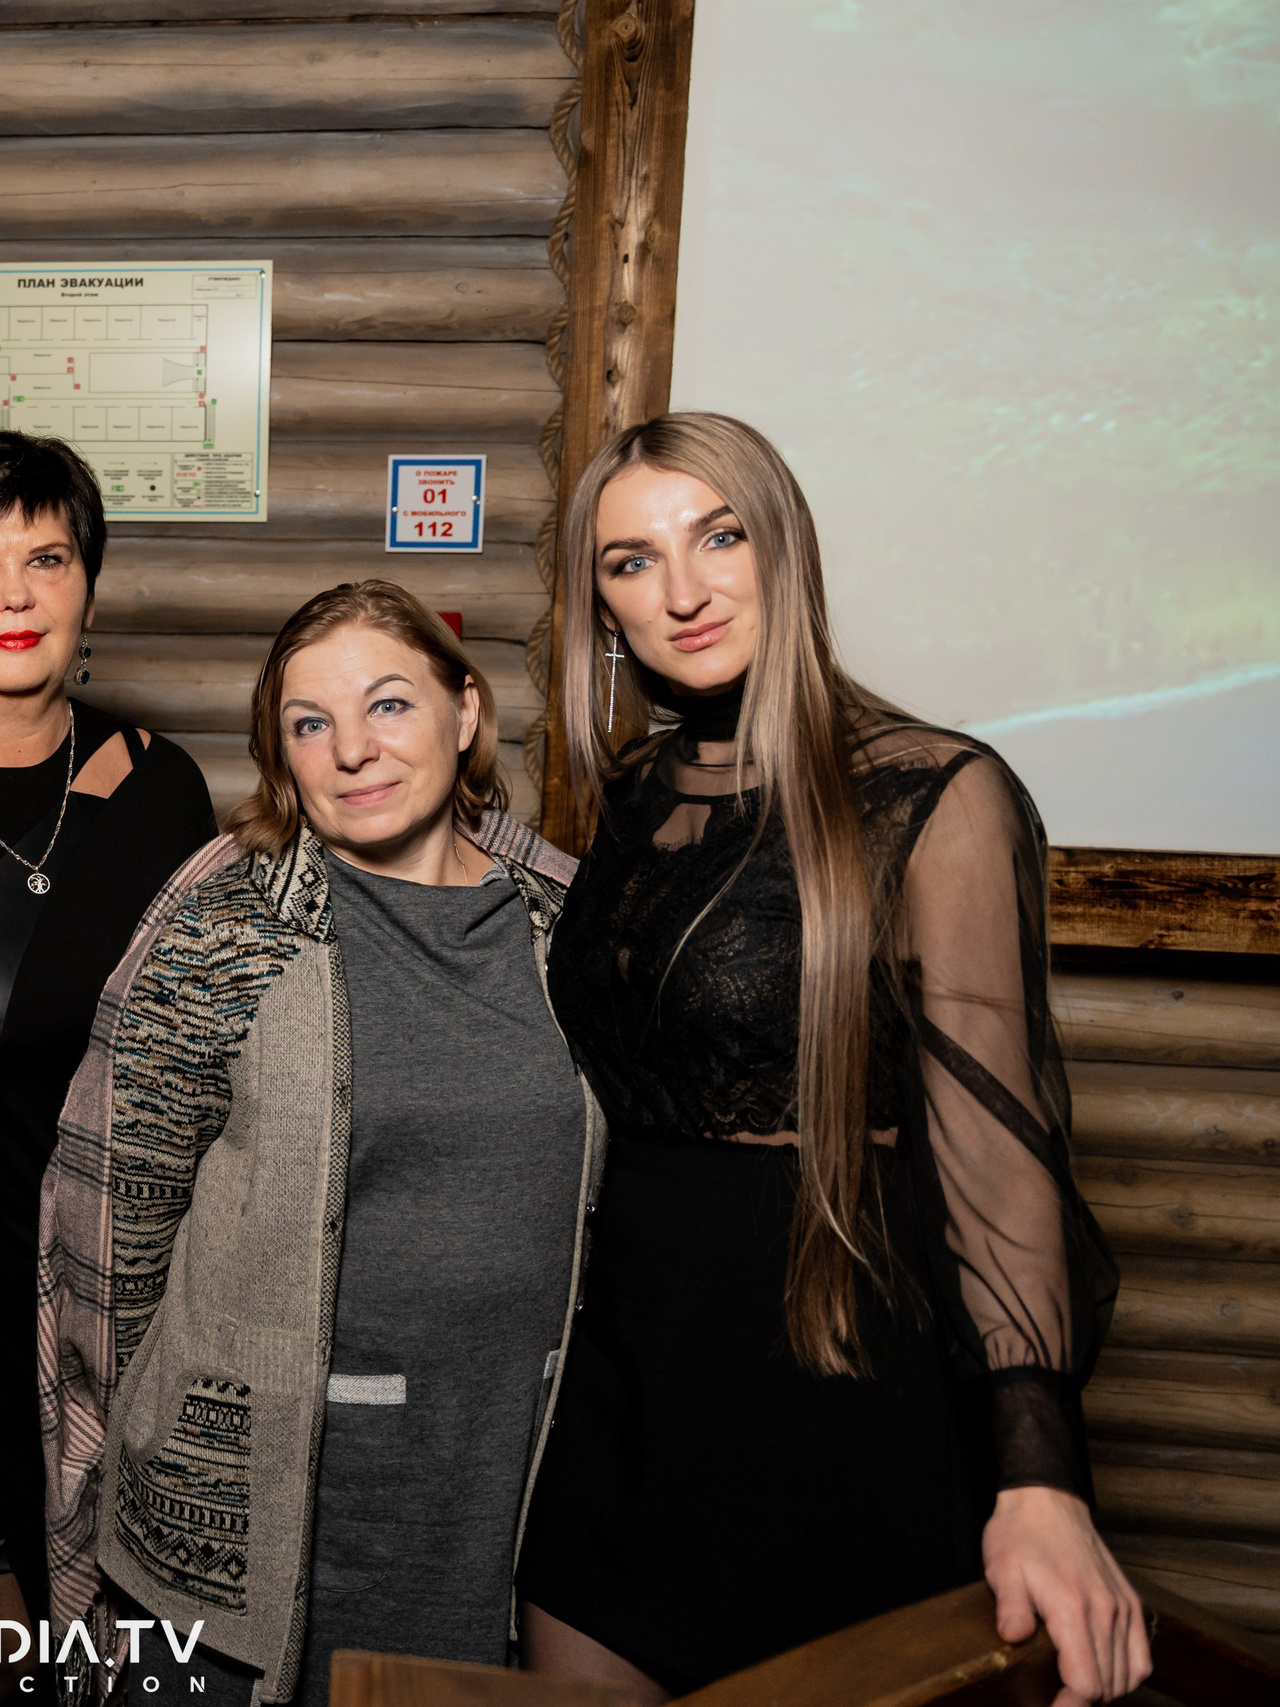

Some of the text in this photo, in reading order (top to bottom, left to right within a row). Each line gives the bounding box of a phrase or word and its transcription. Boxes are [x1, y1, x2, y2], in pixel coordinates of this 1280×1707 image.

[17, 277, 144, 288] ПЛАН ЭВАКУАЦИИ
[423, 488, 448, 504] 01
[414, 521, 454, 537] 112
